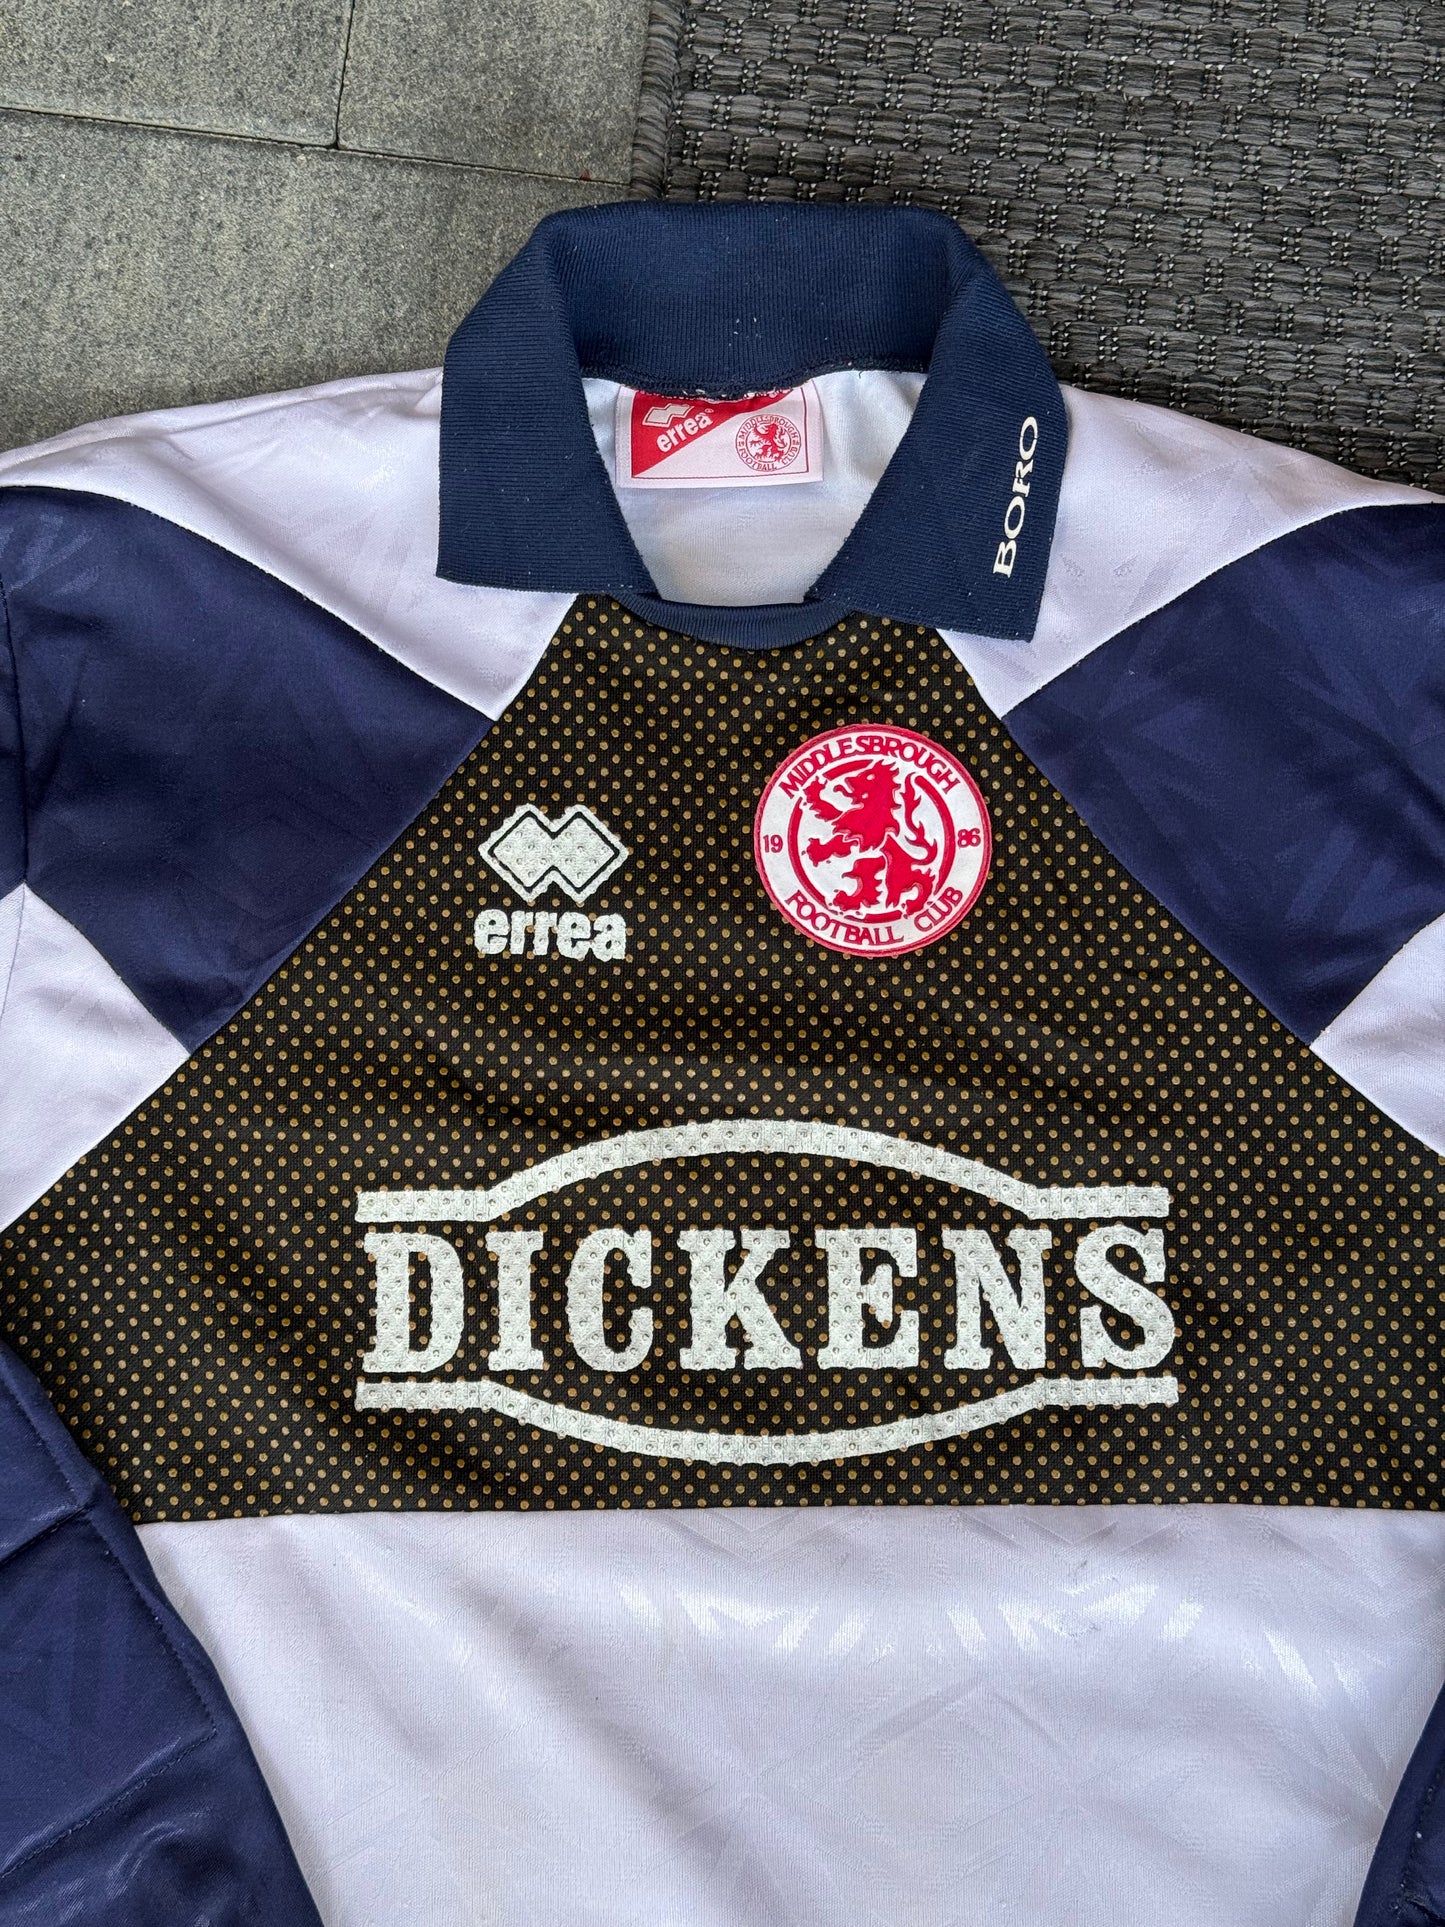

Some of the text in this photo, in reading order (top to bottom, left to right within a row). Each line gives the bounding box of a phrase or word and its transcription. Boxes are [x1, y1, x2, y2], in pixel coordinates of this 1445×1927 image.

[992, 415, 1039, 578] BORO
[778, 735, 961, 799] MIDDLESBROUGH
[763, 834, 784, 853] 19
[957, 828, 981, 849] 86
[473, 908, 628, 963] errea
[785, 886, 964, 945] FOOTBALL CLUB
[362, 1225, 1178, 1374] DICKENS
